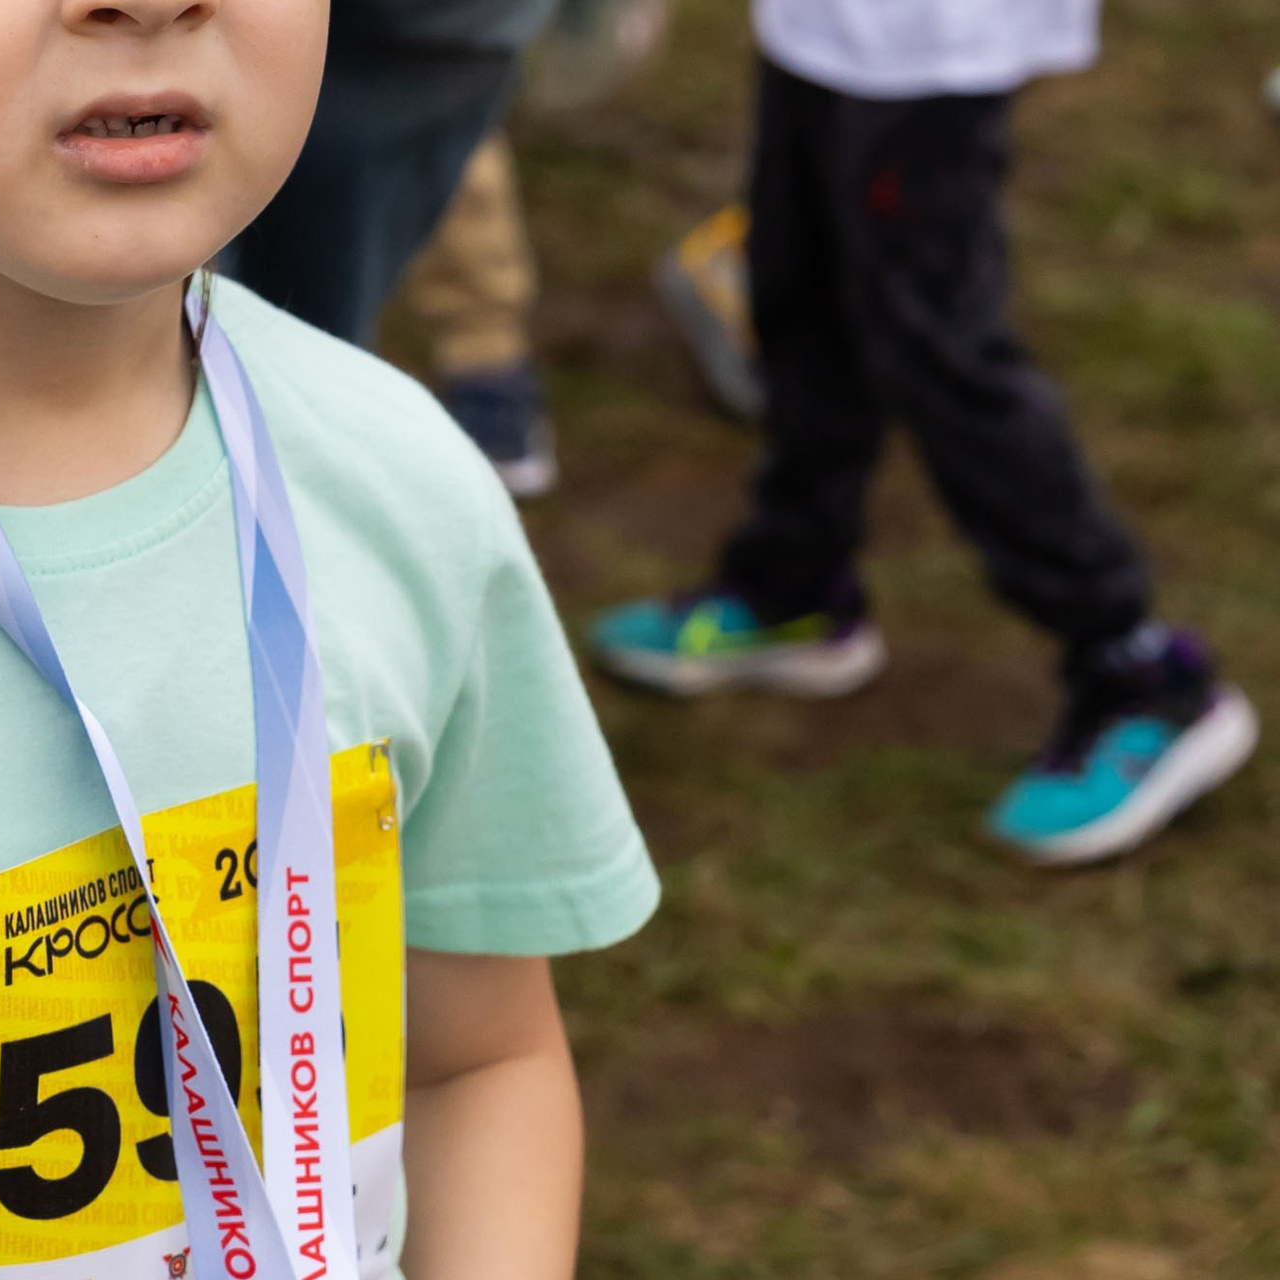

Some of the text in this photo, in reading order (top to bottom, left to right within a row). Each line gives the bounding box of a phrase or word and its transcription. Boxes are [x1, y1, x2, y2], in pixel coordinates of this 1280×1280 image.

[4, 877, 108, 940] КАЛАШНИКОВ
[4, 893, 160, 987] КРОСС
[286, 866, 315, 1014] СПОРТ
